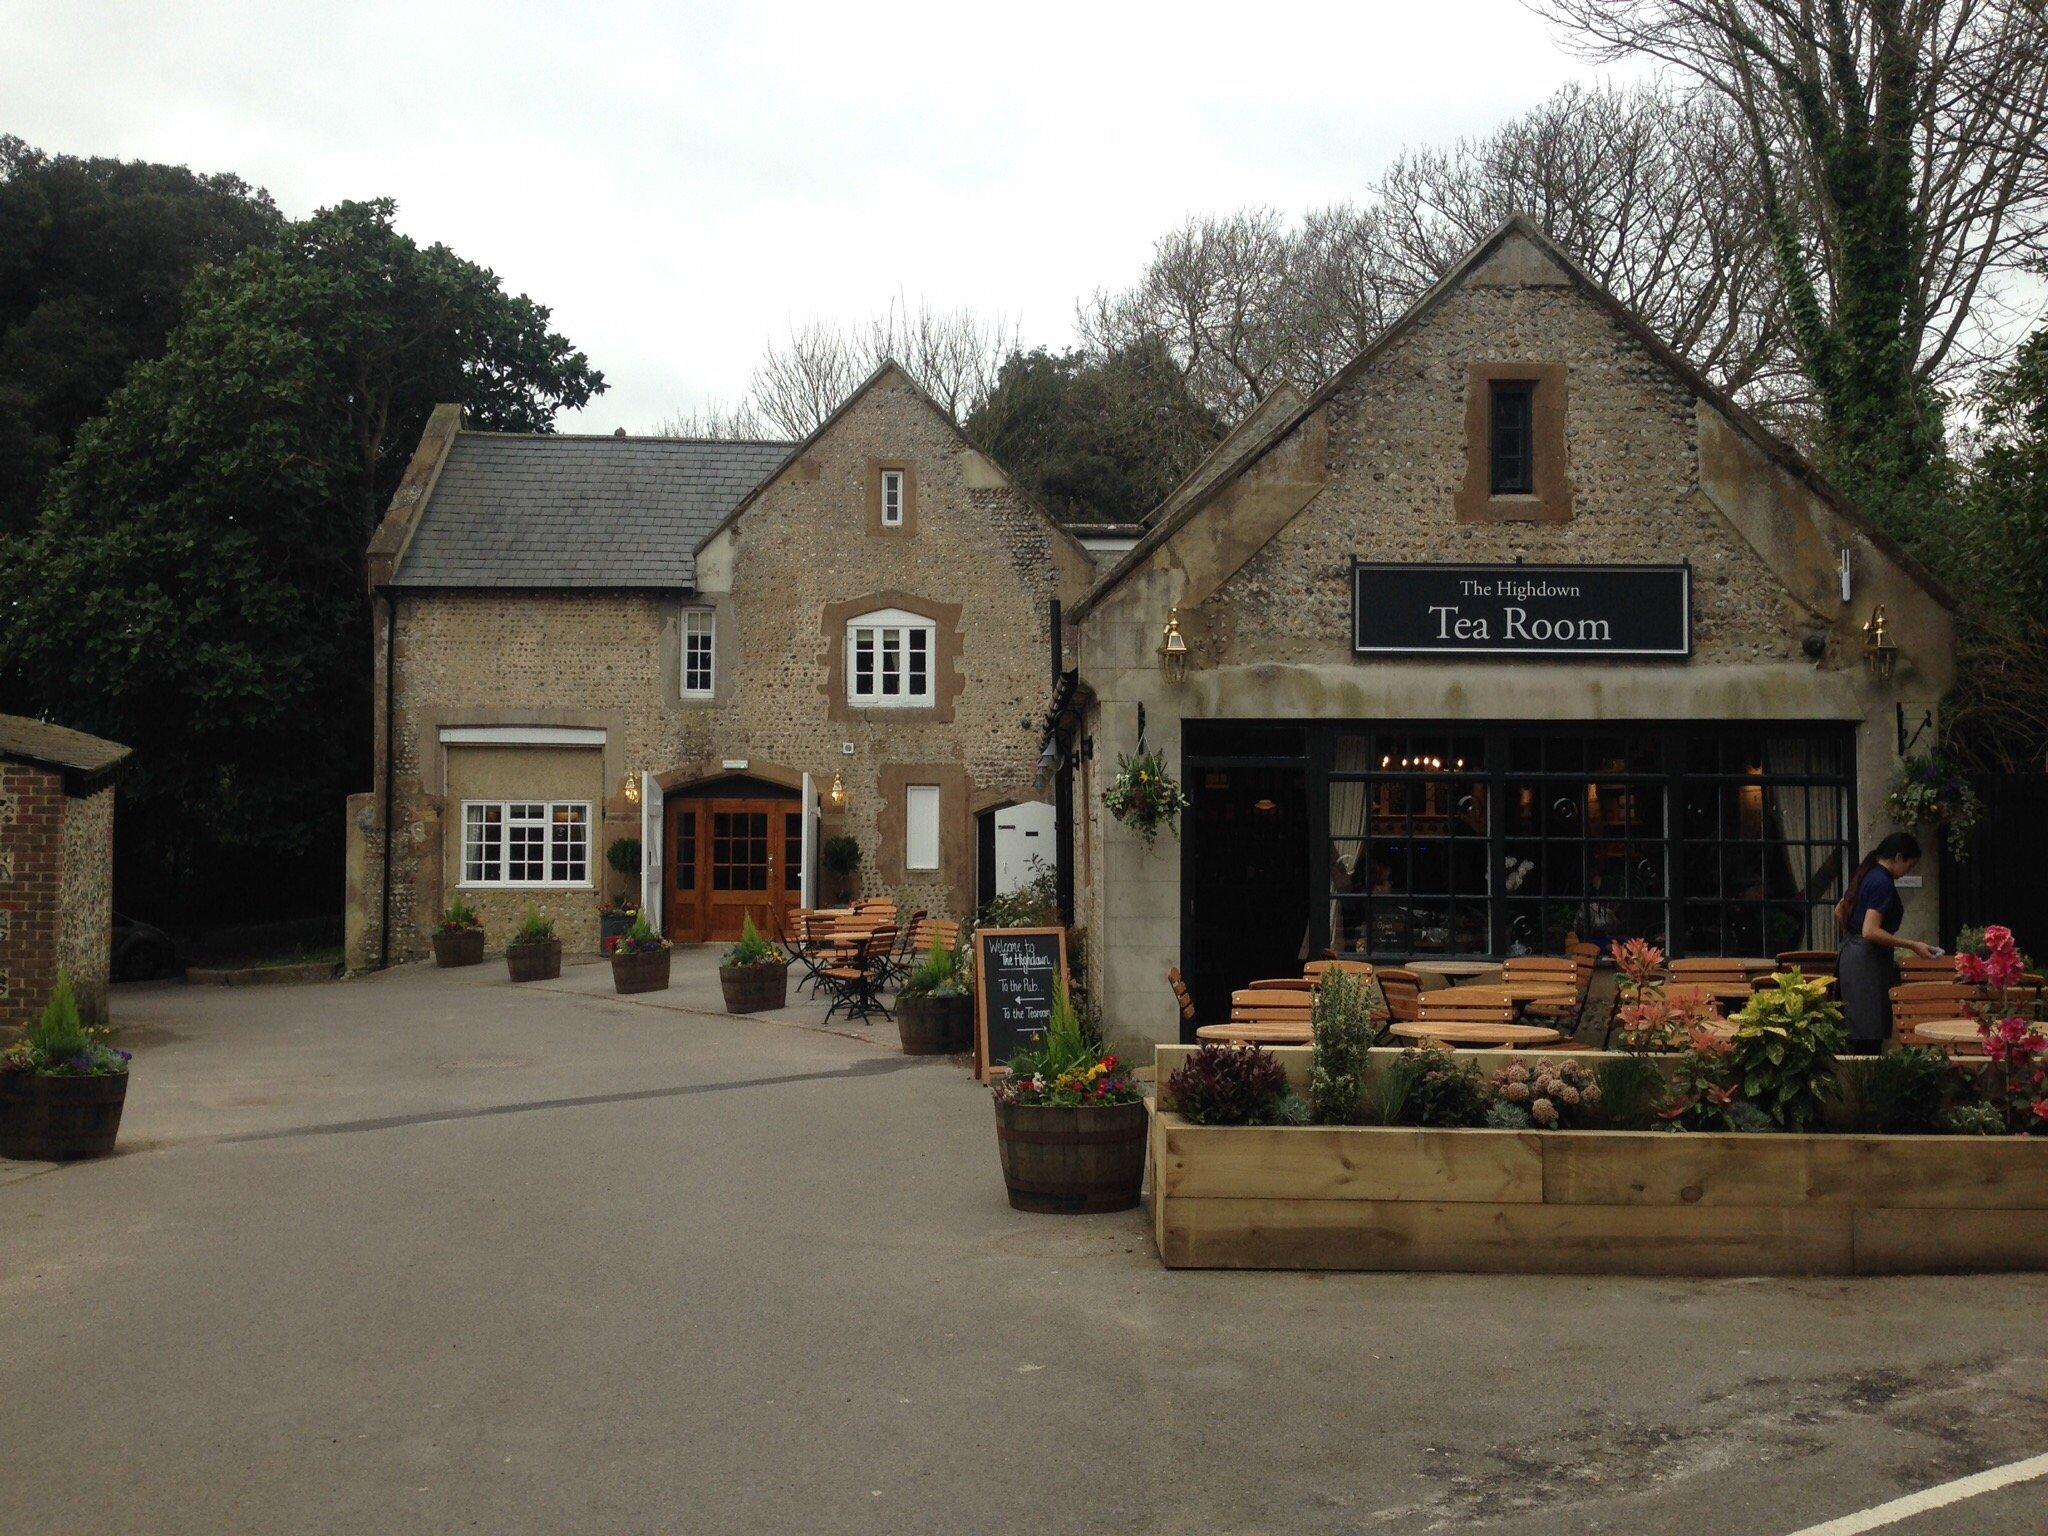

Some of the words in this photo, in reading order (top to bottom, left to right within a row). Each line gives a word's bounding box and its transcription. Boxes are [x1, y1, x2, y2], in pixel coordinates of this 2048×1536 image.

[1459, 580, 1492, 597] The
[1497, 581, 1580, 601] Highdown
[1429, 605, 1490, 640] Tea
[1503, 607, 1611, 641] Room
[988, 939, 1021, 954] Welcome
[1024, 939, 1035, 953] to
[1000, 953, 1013, 966] The
[998, 978, 1009, 992] To
[1009, 979, 1021, 991] the
[1002, 1007, 1010, 1019] To
[1012, 1007, 1024, 1019] the
